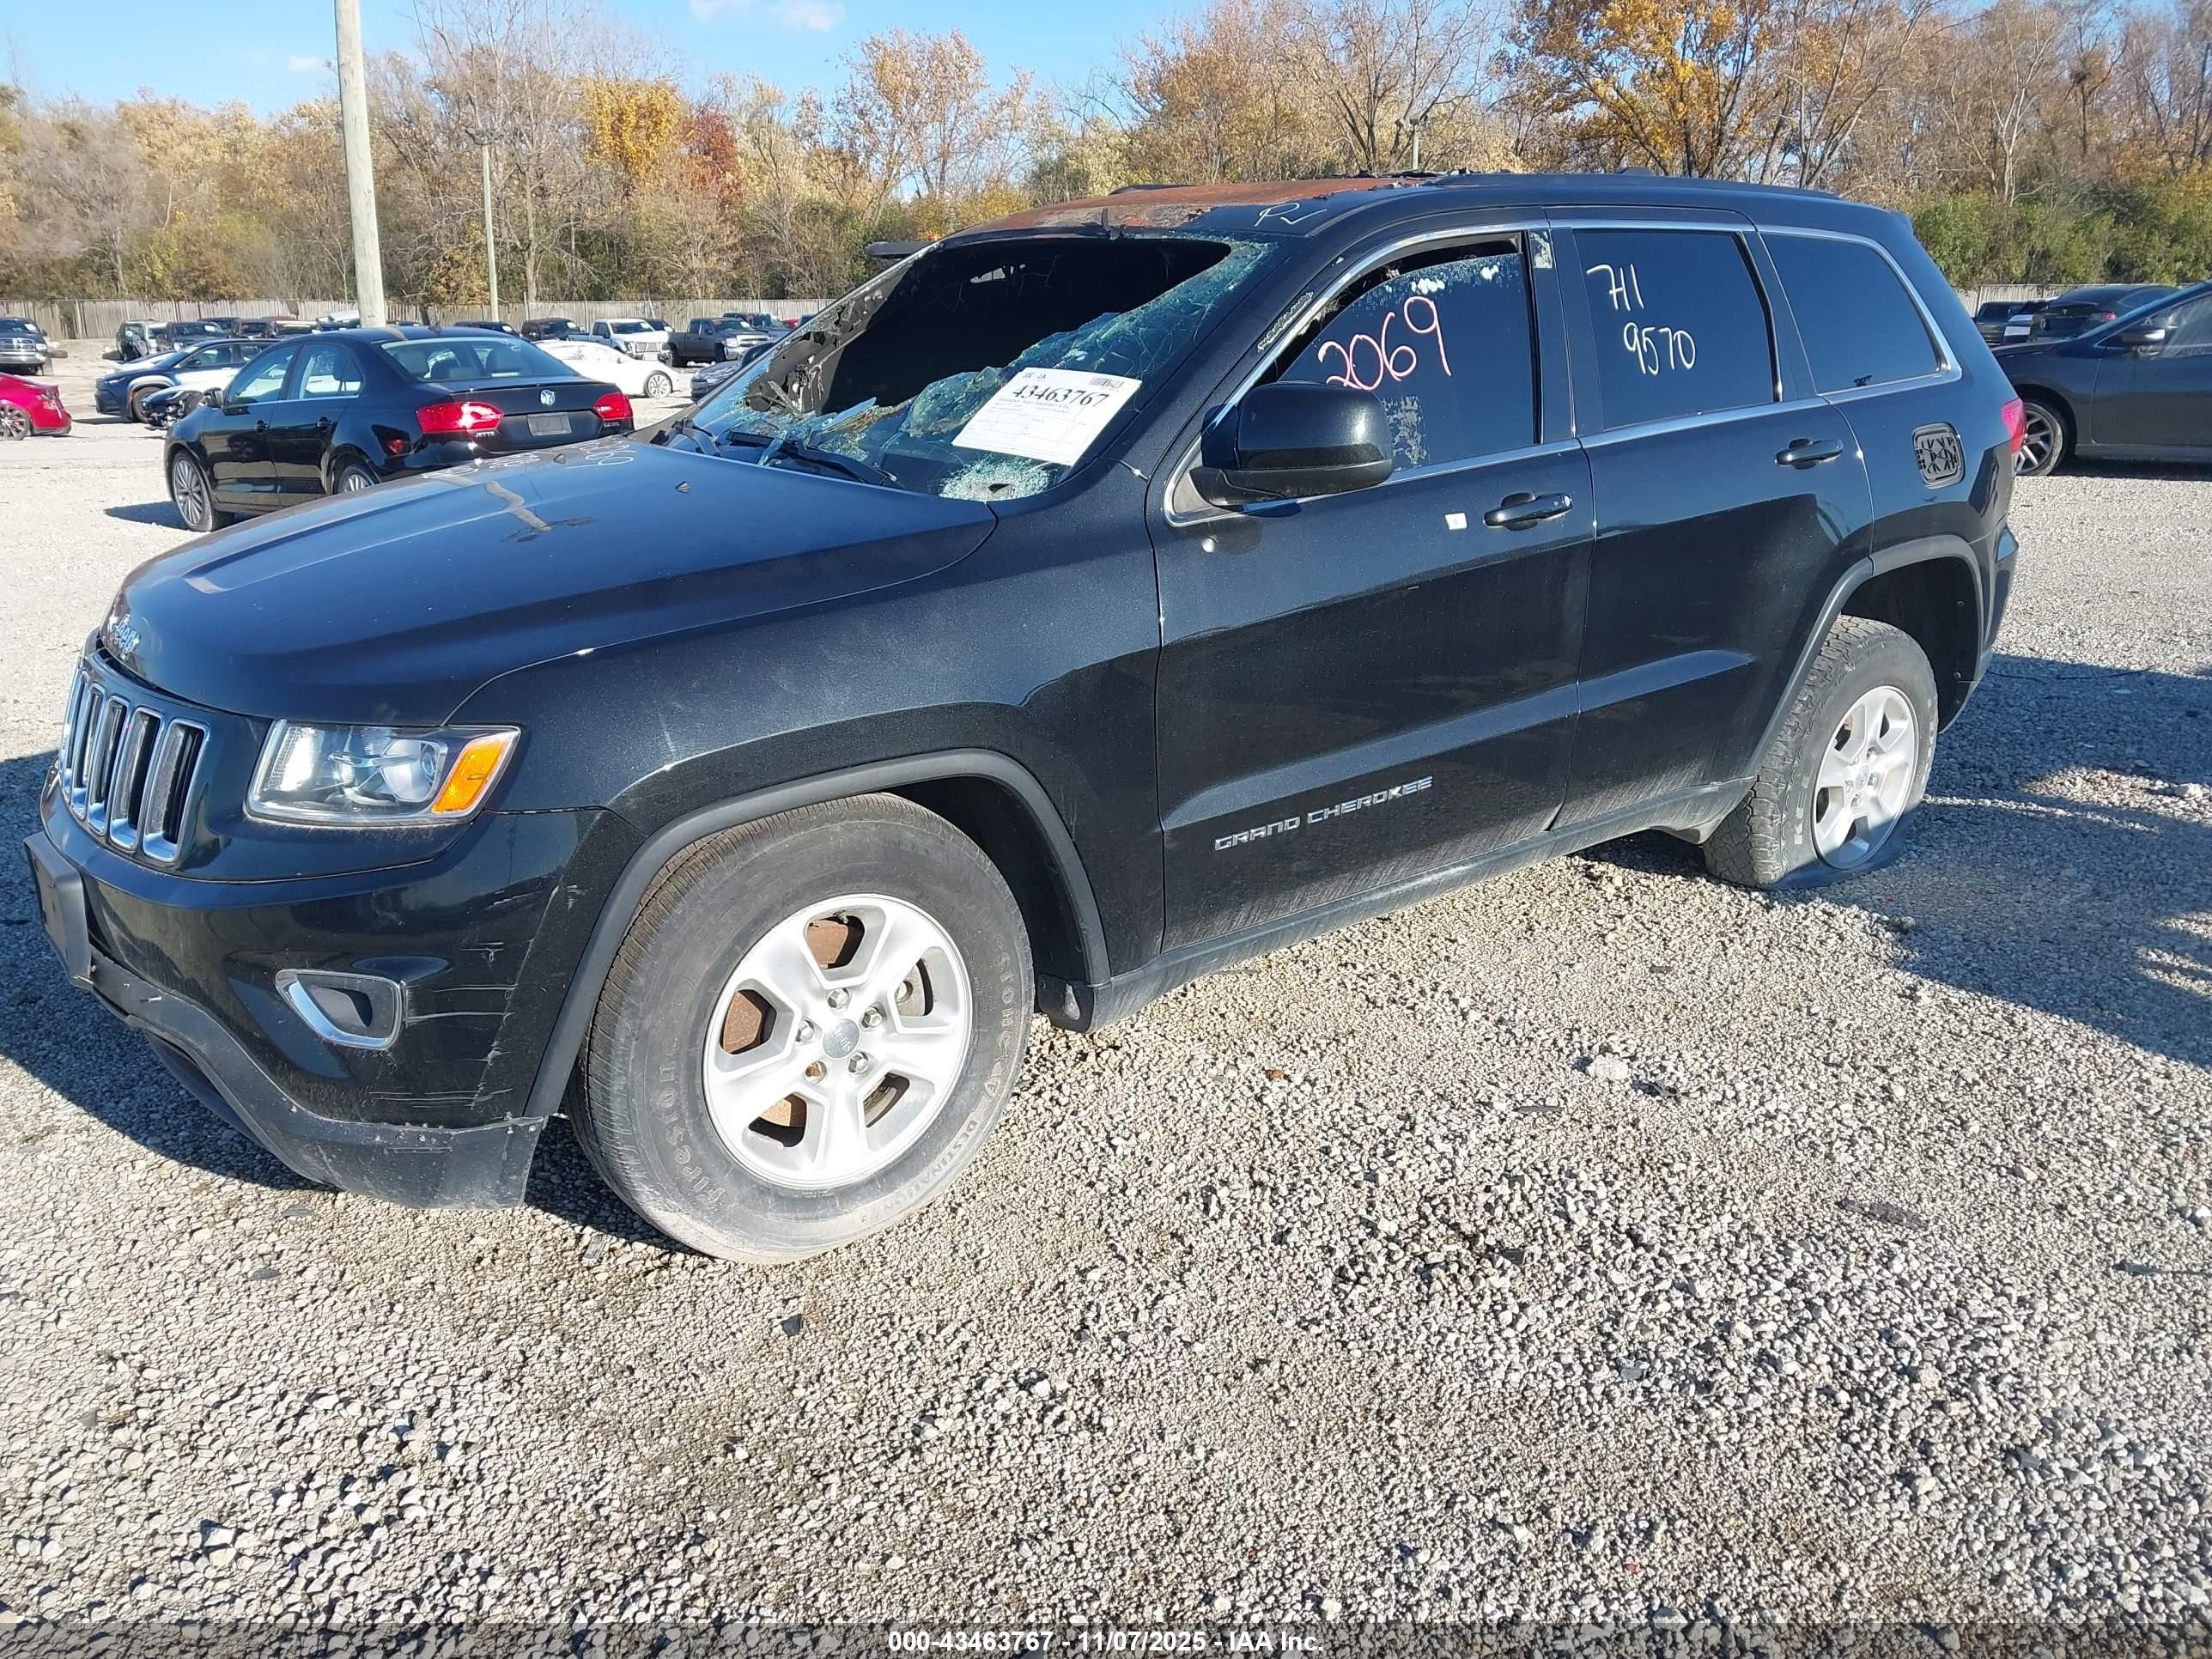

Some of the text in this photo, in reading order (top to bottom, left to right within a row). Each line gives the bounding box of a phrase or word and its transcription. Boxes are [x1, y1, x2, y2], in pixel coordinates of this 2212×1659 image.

[1317, 295, 1453, 392] 2069
[1623, 322, 1697, 376] 9570
[1012, 384, 1110, 408] 43463767
[1213, 776, 1433, 851] GRAND CHEROKEE
